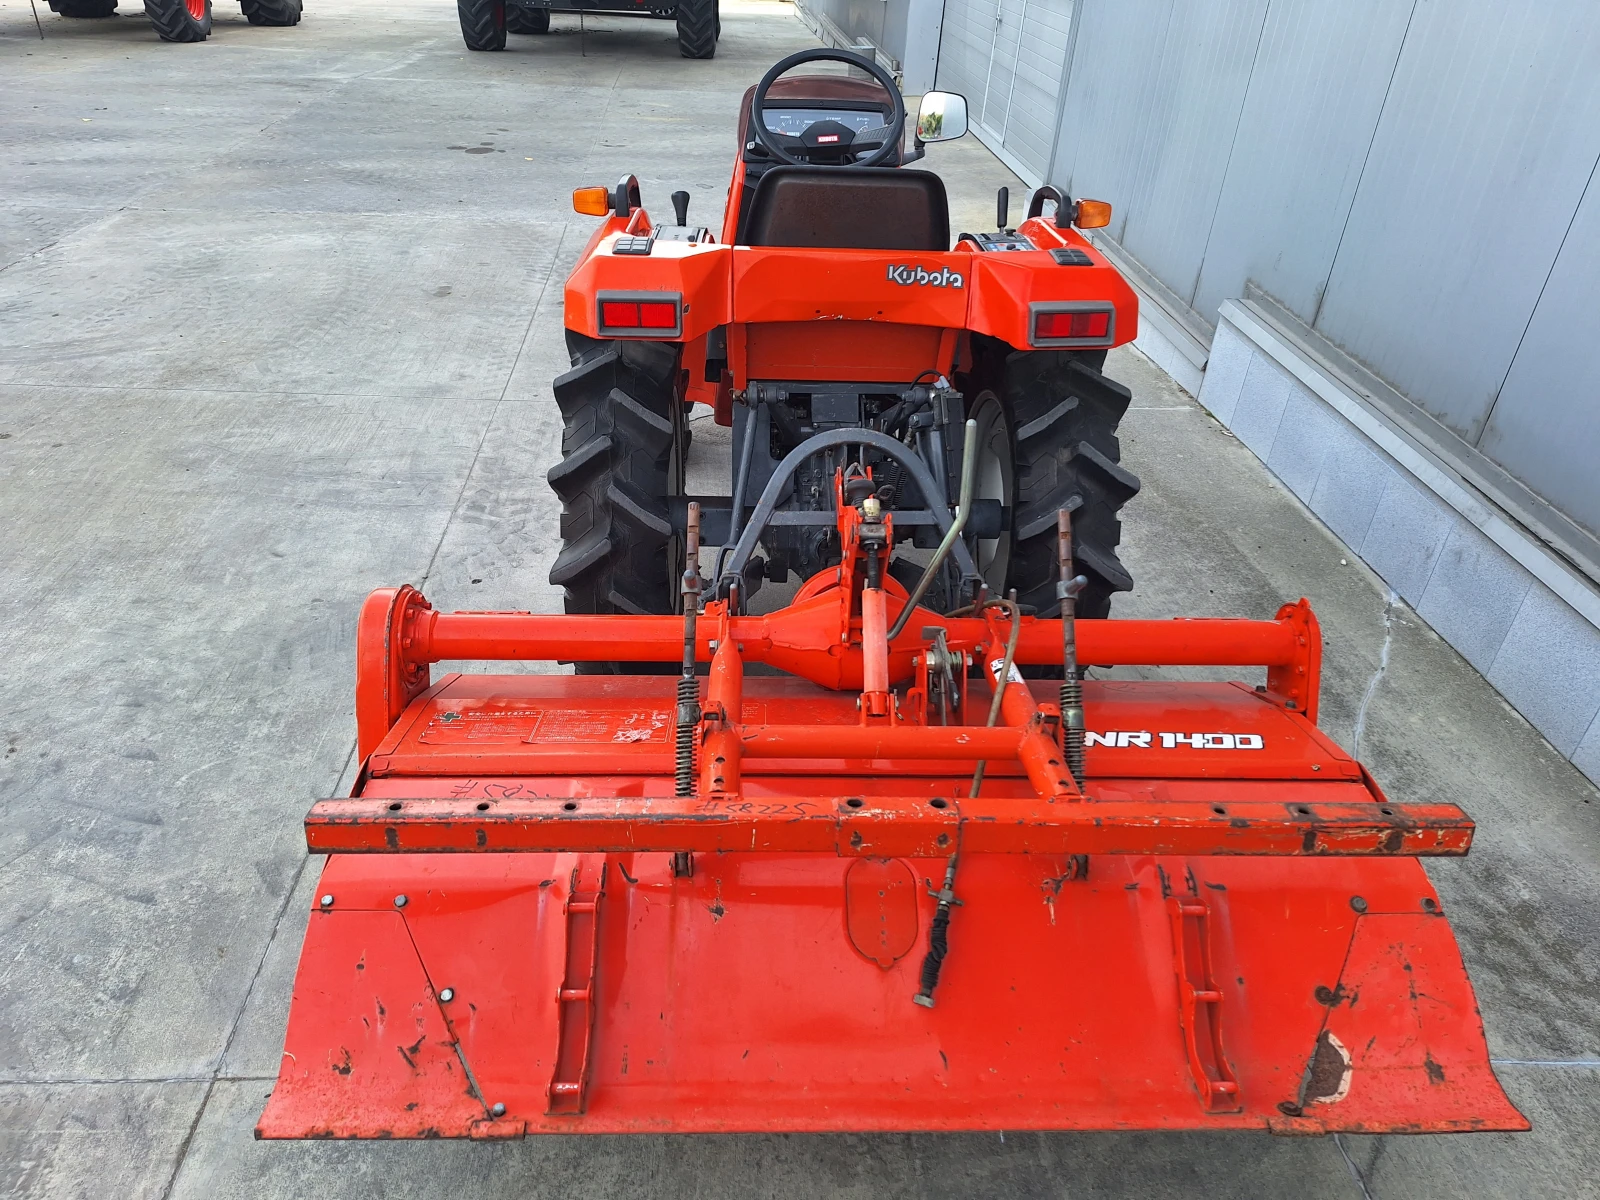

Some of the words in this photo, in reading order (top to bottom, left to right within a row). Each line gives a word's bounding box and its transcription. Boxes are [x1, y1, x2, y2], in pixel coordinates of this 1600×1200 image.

[887, 264, 965, 288] Kubota
[1083, 731, 1153, 748] NR
[1157, 732, 1265, 750] 1400
